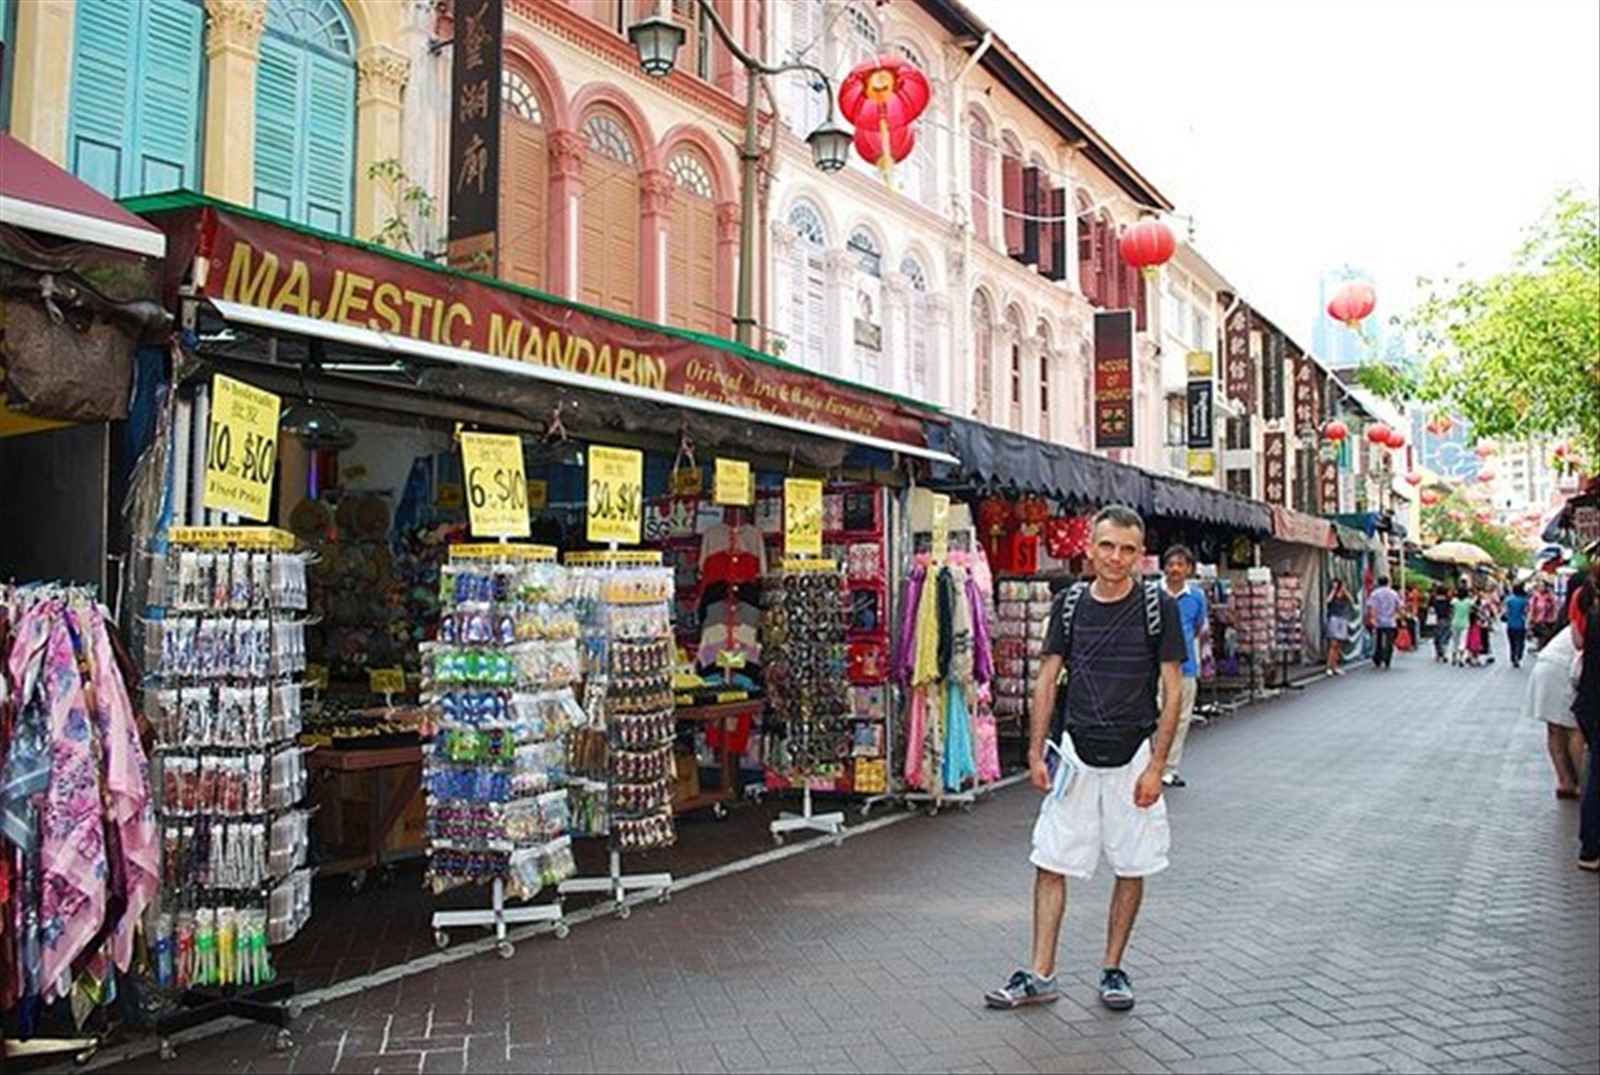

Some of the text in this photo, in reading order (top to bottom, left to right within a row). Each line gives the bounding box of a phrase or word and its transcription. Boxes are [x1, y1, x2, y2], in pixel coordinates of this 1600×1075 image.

[223, 241, 667, 391] MAJESTIC MANDARIN
[209, 421, 231, 472] 10
[241, 431, 275, 485] $10
[469, 467, 486, 509] 6
